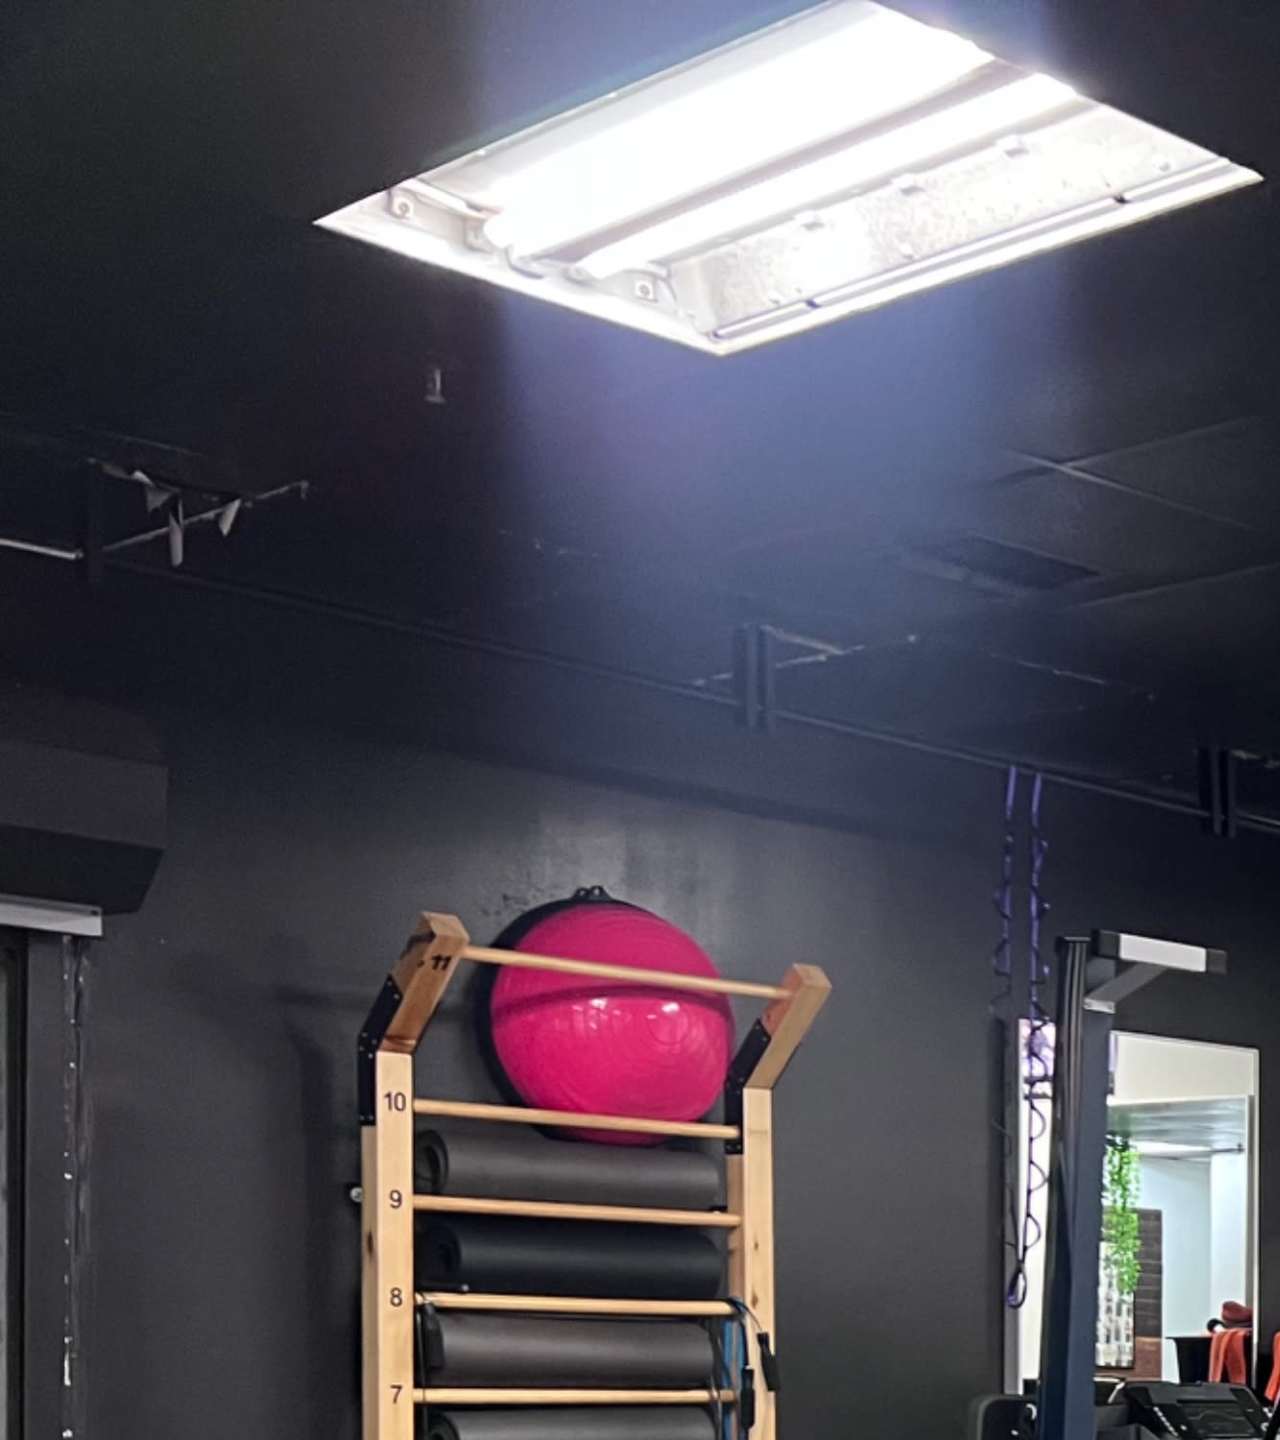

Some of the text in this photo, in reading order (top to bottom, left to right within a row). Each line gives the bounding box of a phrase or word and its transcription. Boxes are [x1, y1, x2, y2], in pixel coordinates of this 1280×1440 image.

[432, 954, 451, 970] 11
[384, 1091, 407, 1112] 10
[389, 1189, 403, 1209] 9
[390, 1287, 403, 1307] 8
[390, 1384, 403, 1405] 7
